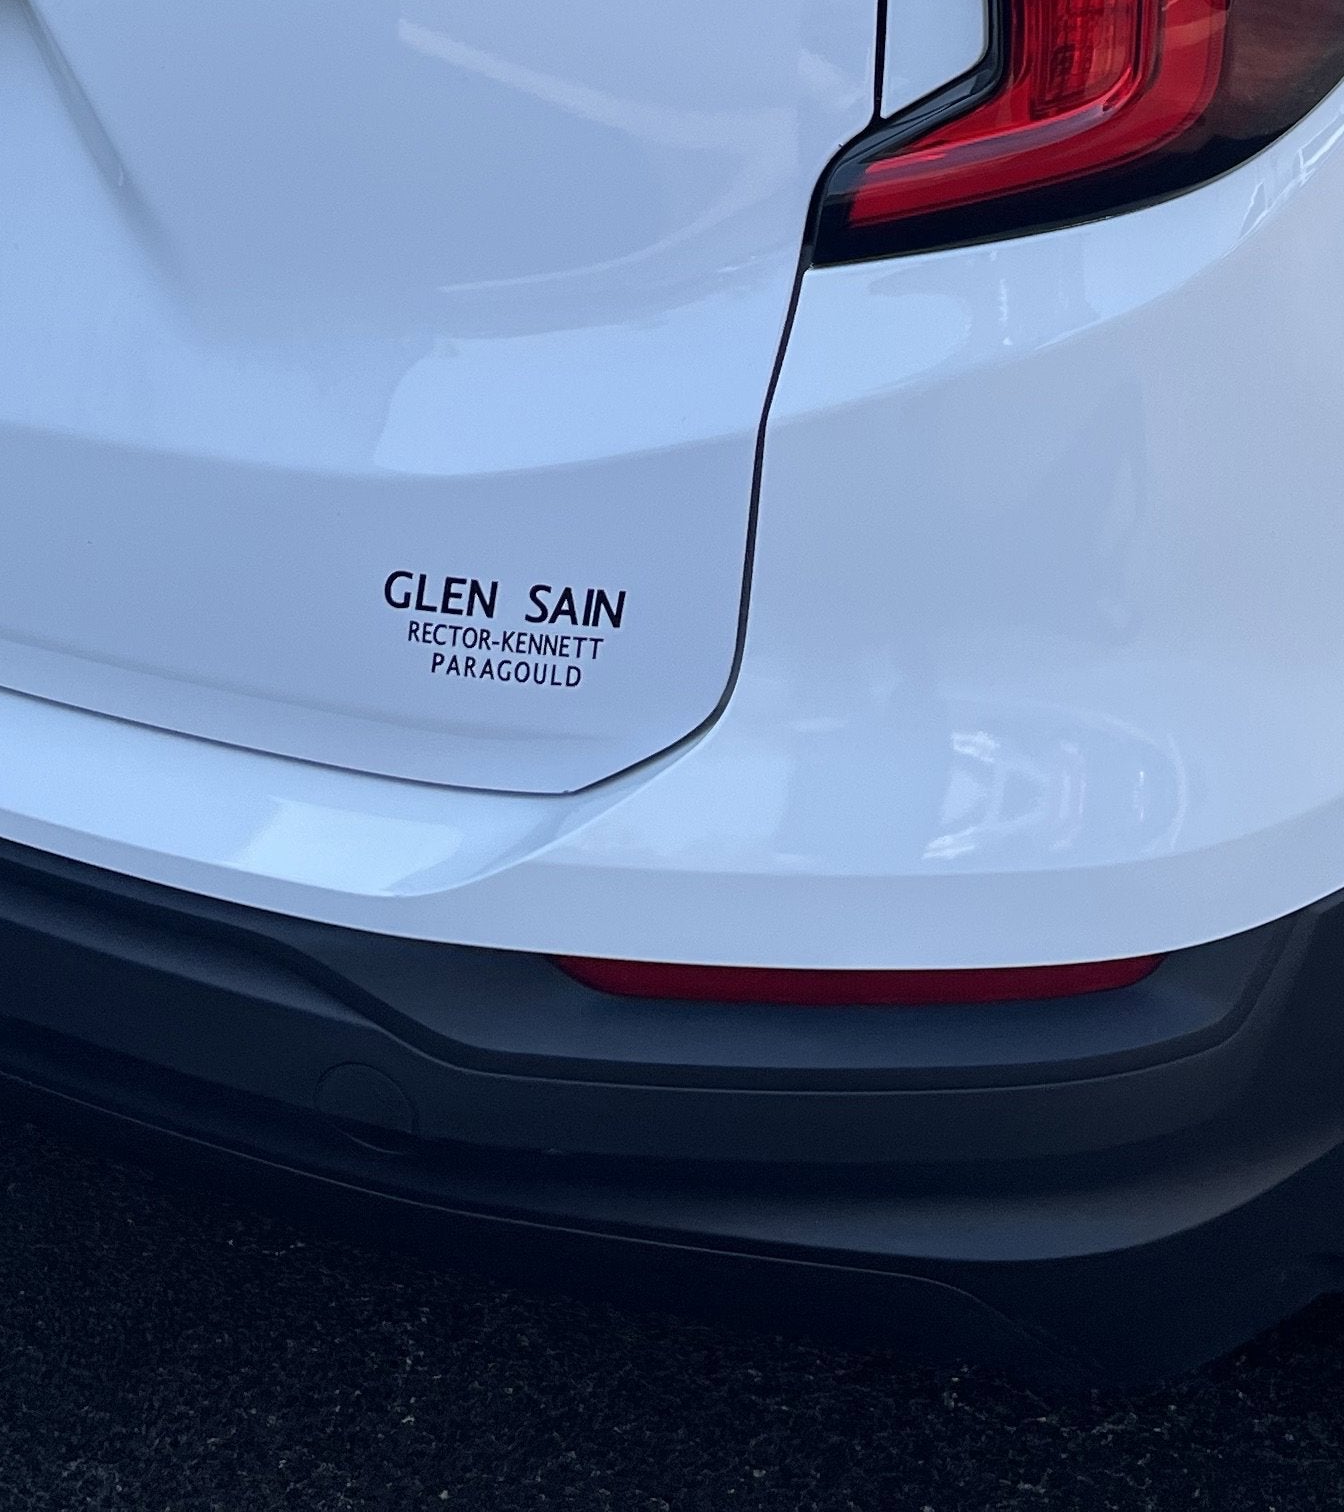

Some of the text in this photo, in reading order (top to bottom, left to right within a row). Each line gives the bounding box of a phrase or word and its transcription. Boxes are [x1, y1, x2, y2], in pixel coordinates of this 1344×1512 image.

[383, 570, 627, 629] GLEN SAIN
[407, 620, 605, 660] RECTOR-KENNETT
[430, 651, 582, 688] PARAGOULD
